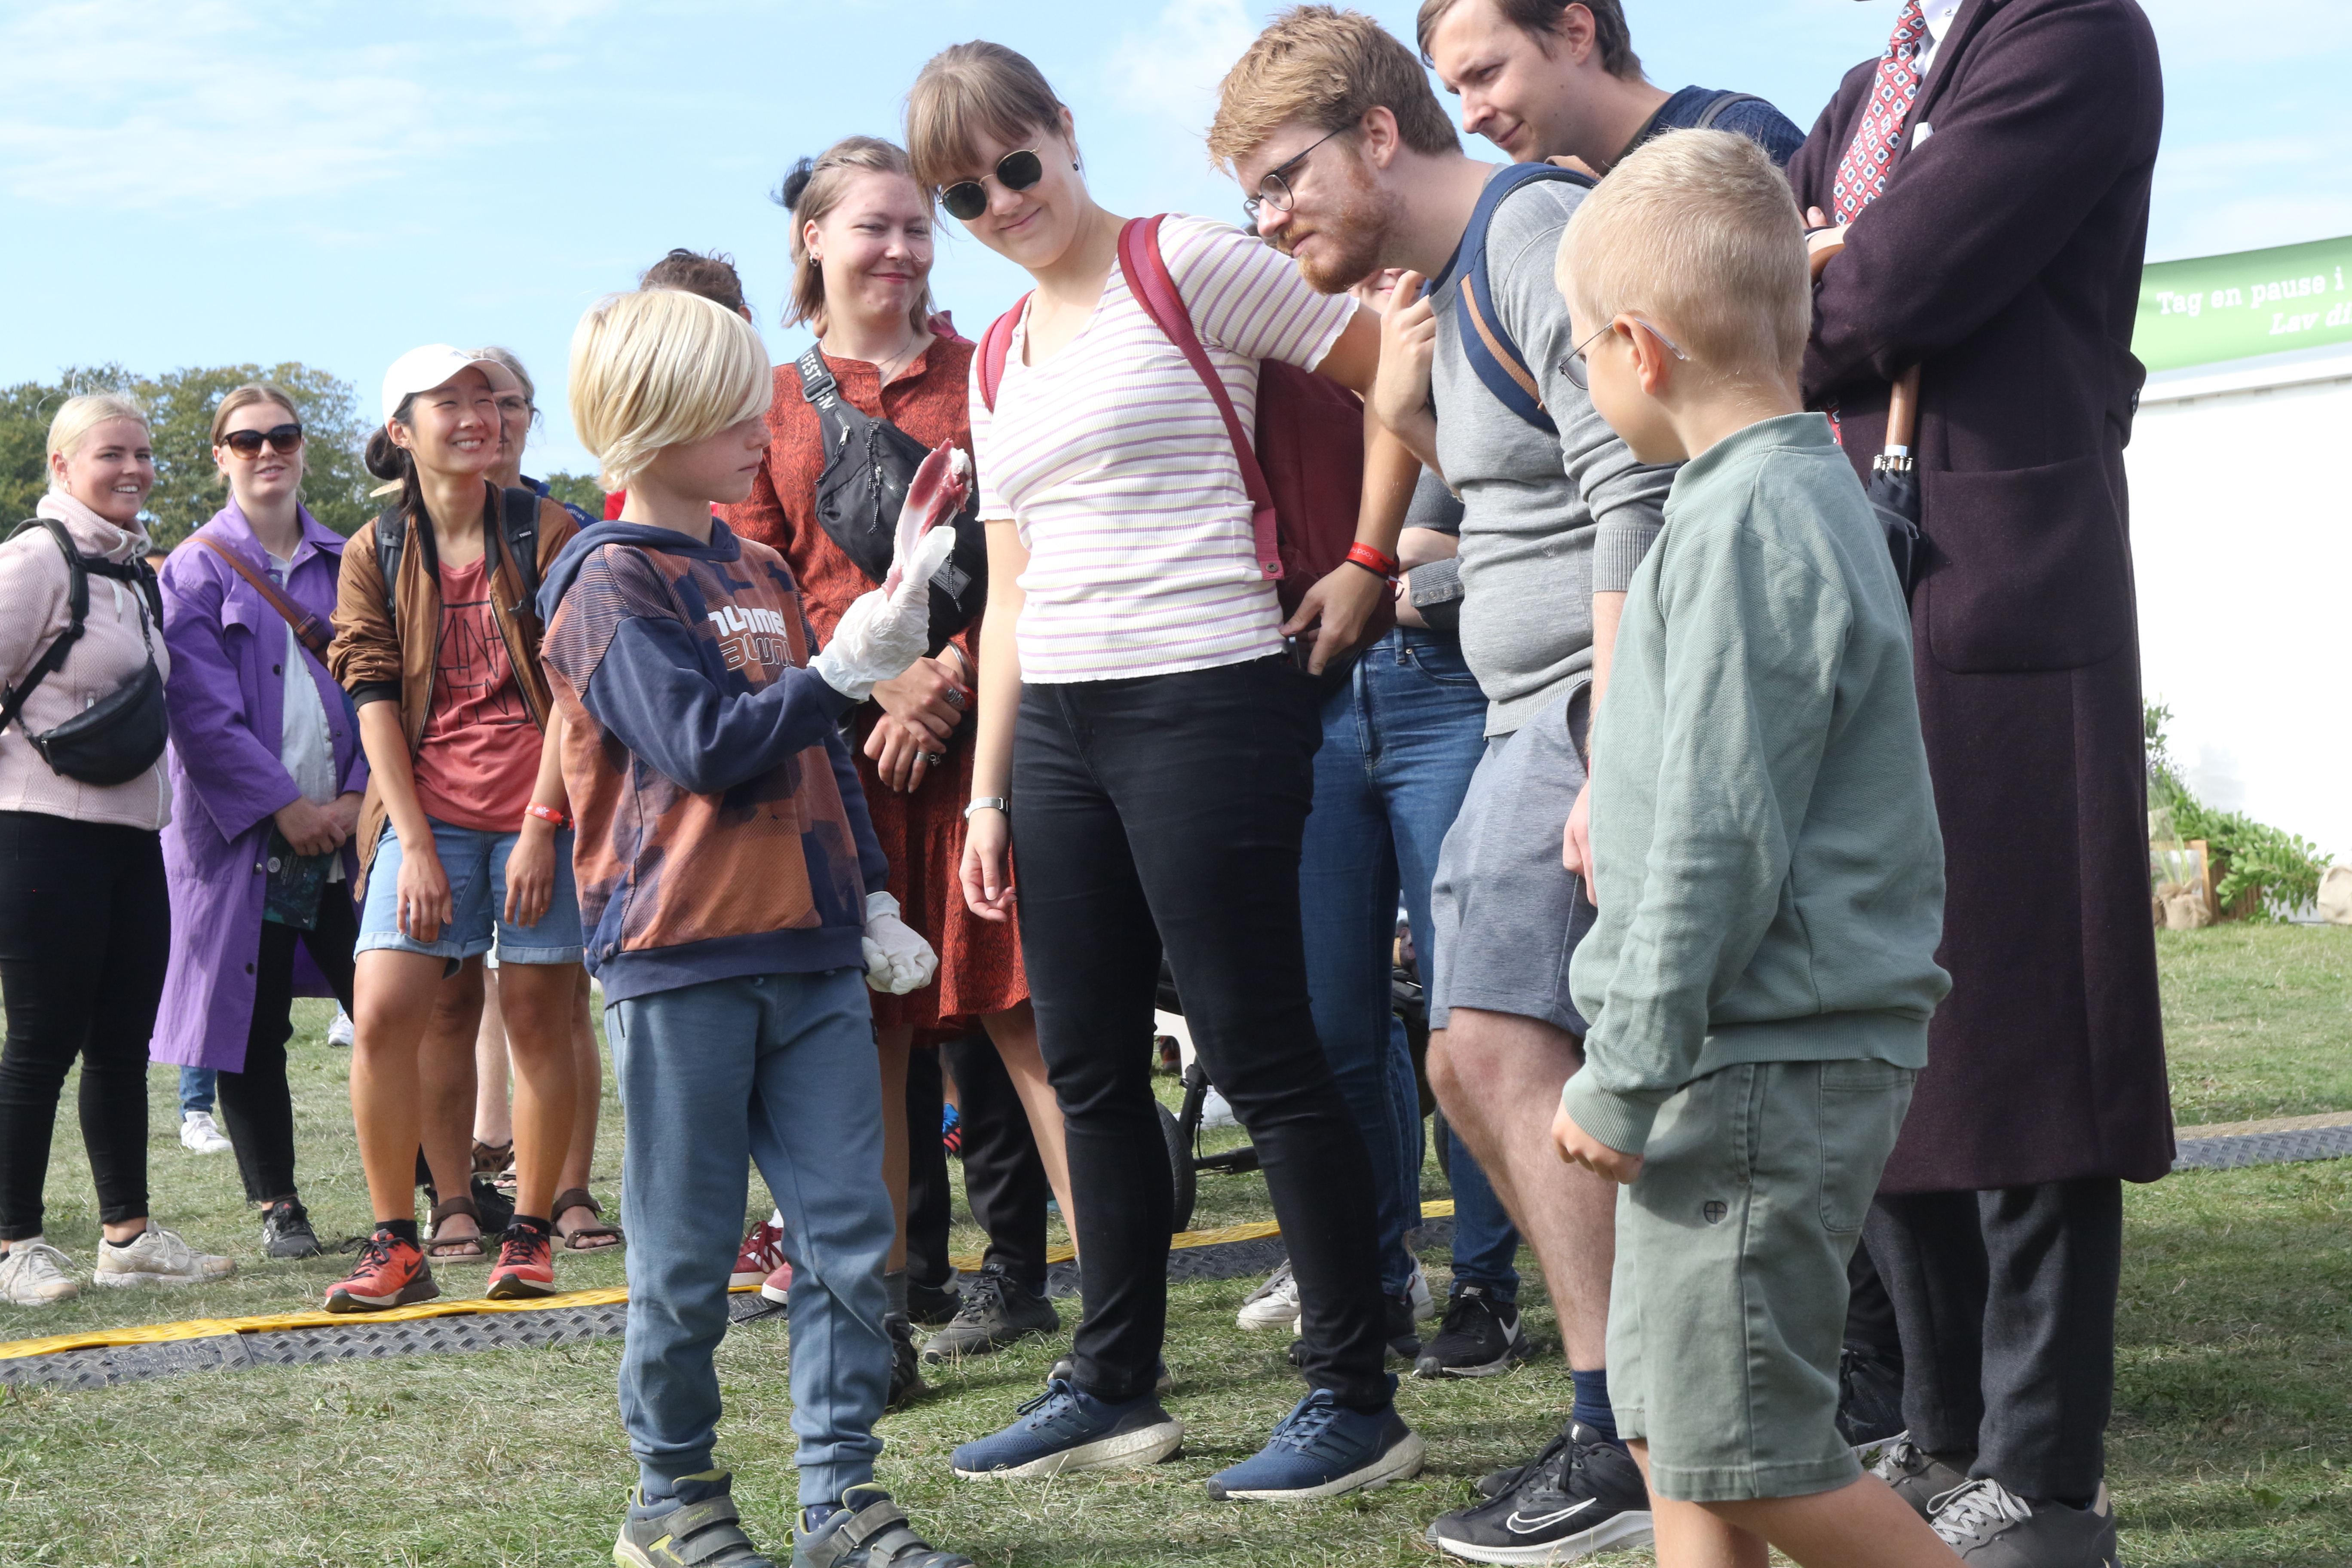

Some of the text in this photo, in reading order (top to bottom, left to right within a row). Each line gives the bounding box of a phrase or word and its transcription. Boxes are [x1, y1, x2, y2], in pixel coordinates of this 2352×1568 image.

[2156, 266, 2345, 317] Tag en pause i
[2269, 301, 2352, 335] Lav di
[1357, 548, 1374, 560] Food
[1463, 1286, 1482, 1296] NIKE
[687, 1506, 713, 1522] superfit
